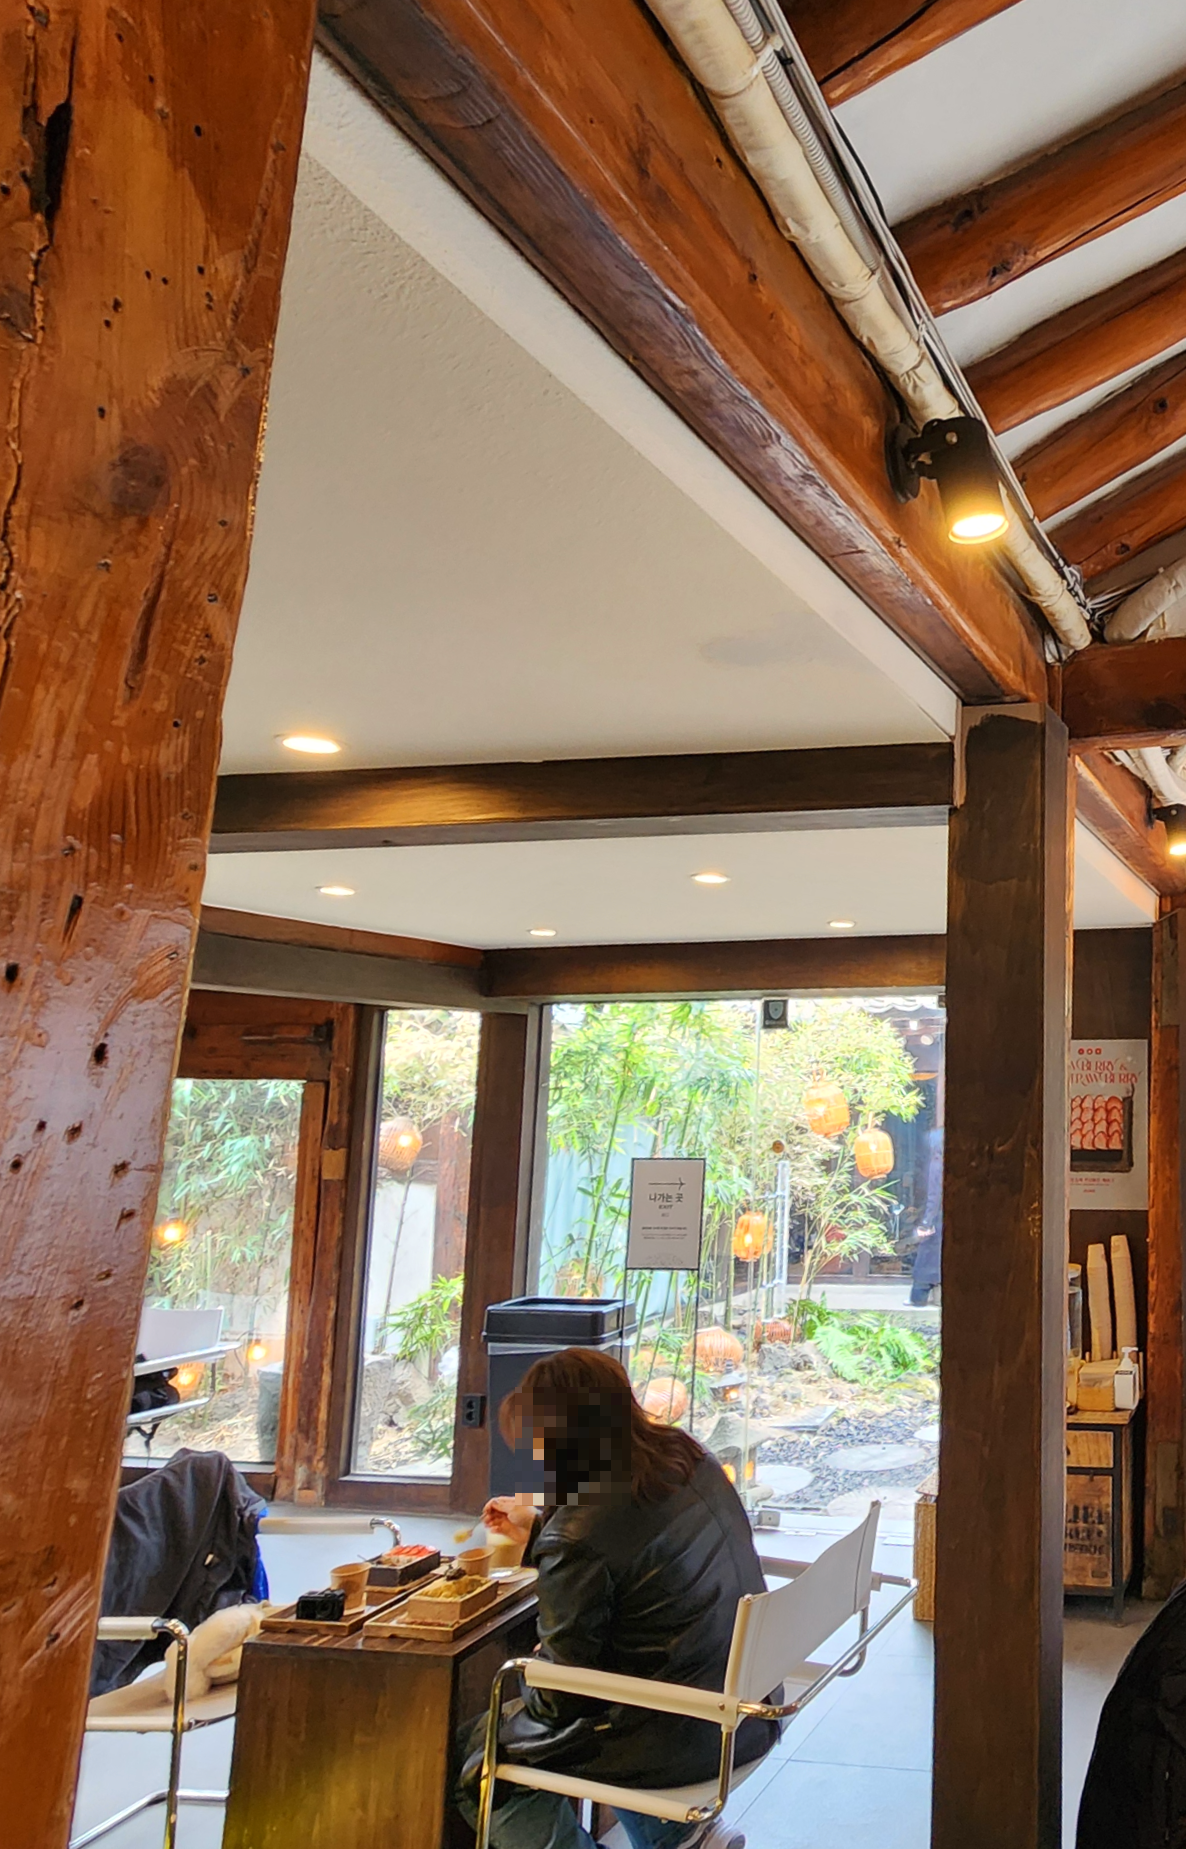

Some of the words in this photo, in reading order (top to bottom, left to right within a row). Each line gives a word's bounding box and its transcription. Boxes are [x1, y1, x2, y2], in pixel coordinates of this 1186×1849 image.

[1070, 1071, 1143, 1086] TRAWBERRY
[649, 1192, 673, 1203] 나가는
[675, 1192, 684, 1203] 곳
